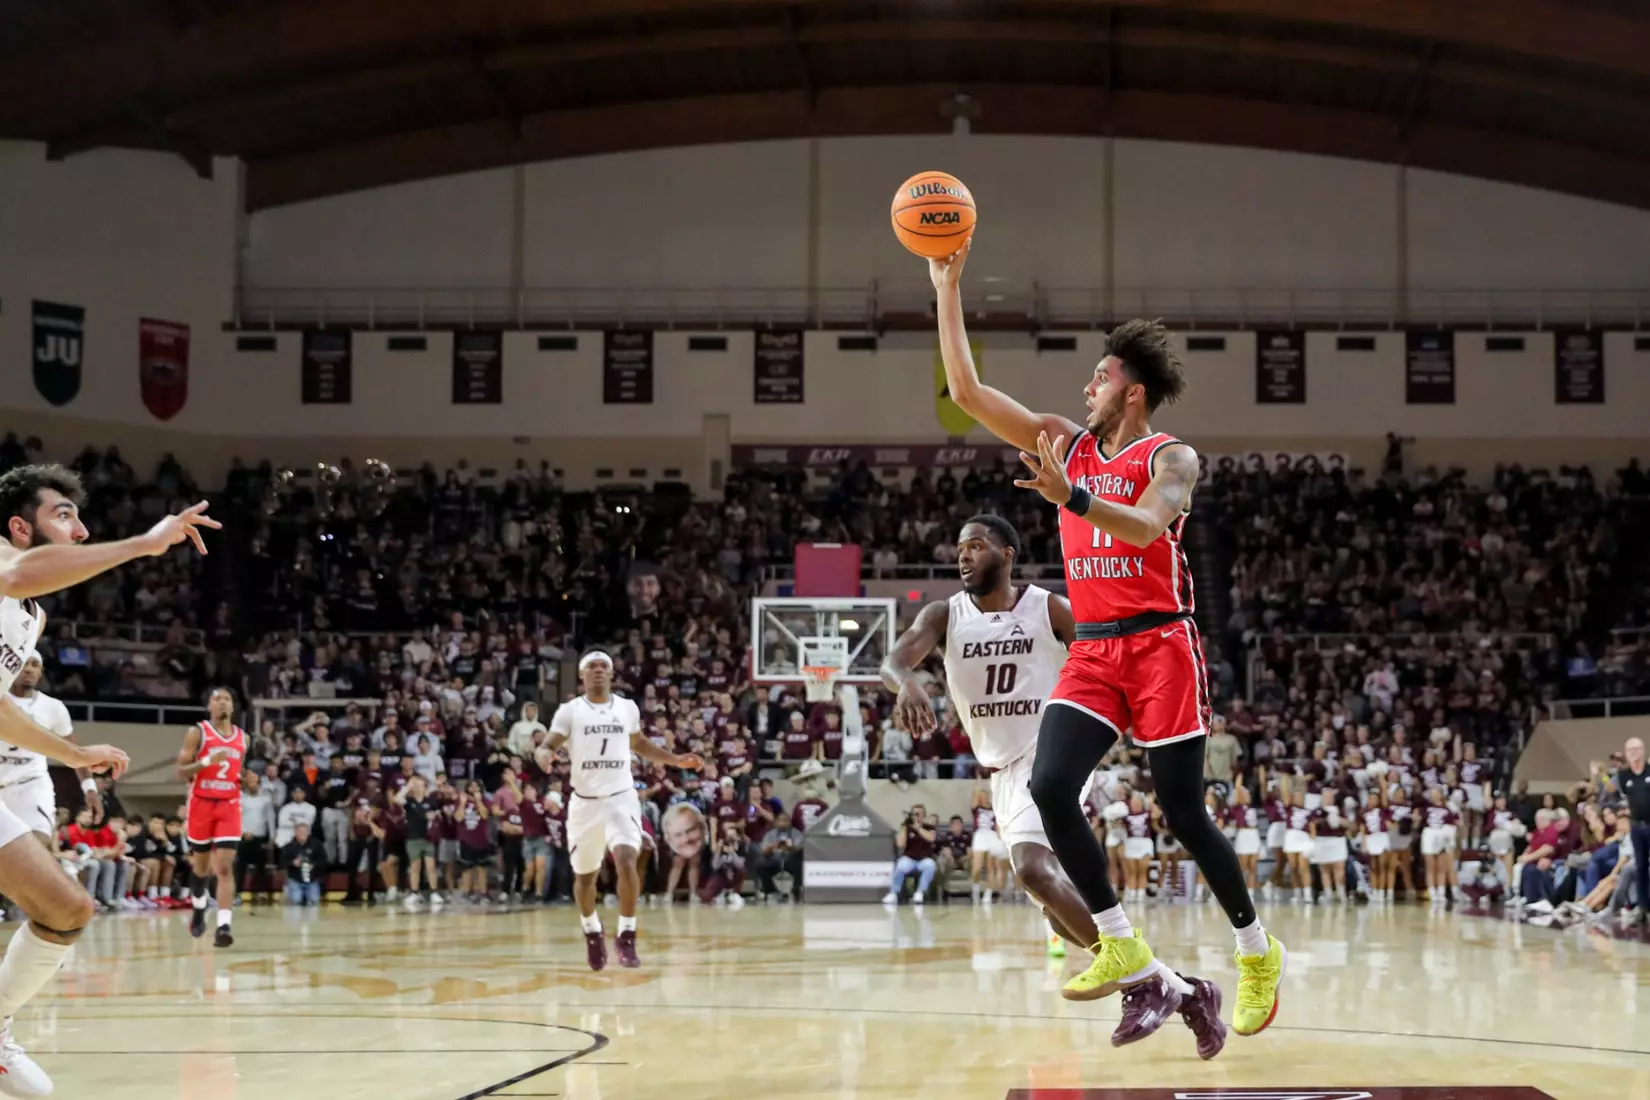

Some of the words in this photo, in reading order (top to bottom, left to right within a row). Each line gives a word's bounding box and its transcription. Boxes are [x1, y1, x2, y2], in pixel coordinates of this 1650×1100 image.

[910, 182, 965, 199] Wilson
[919, 211, 960, 225] NCAA
[36, 334, 80, 366] JU
[1076, 473, 1136, 499] WESTERN
[1067, 557, 1144, 580] KENTUCKY
[963, 637, 1034, 660] EASTERN
[985, 663, 1018, 696] 10
[969, 699, 1041, 720] KENTUCKY
[584, 724, 625, 735] EASTERN
[600, 738, 609, 755] 1
[216, 760, 231, 779] 2
[581, 760, 625, 770] KENTUCKY
